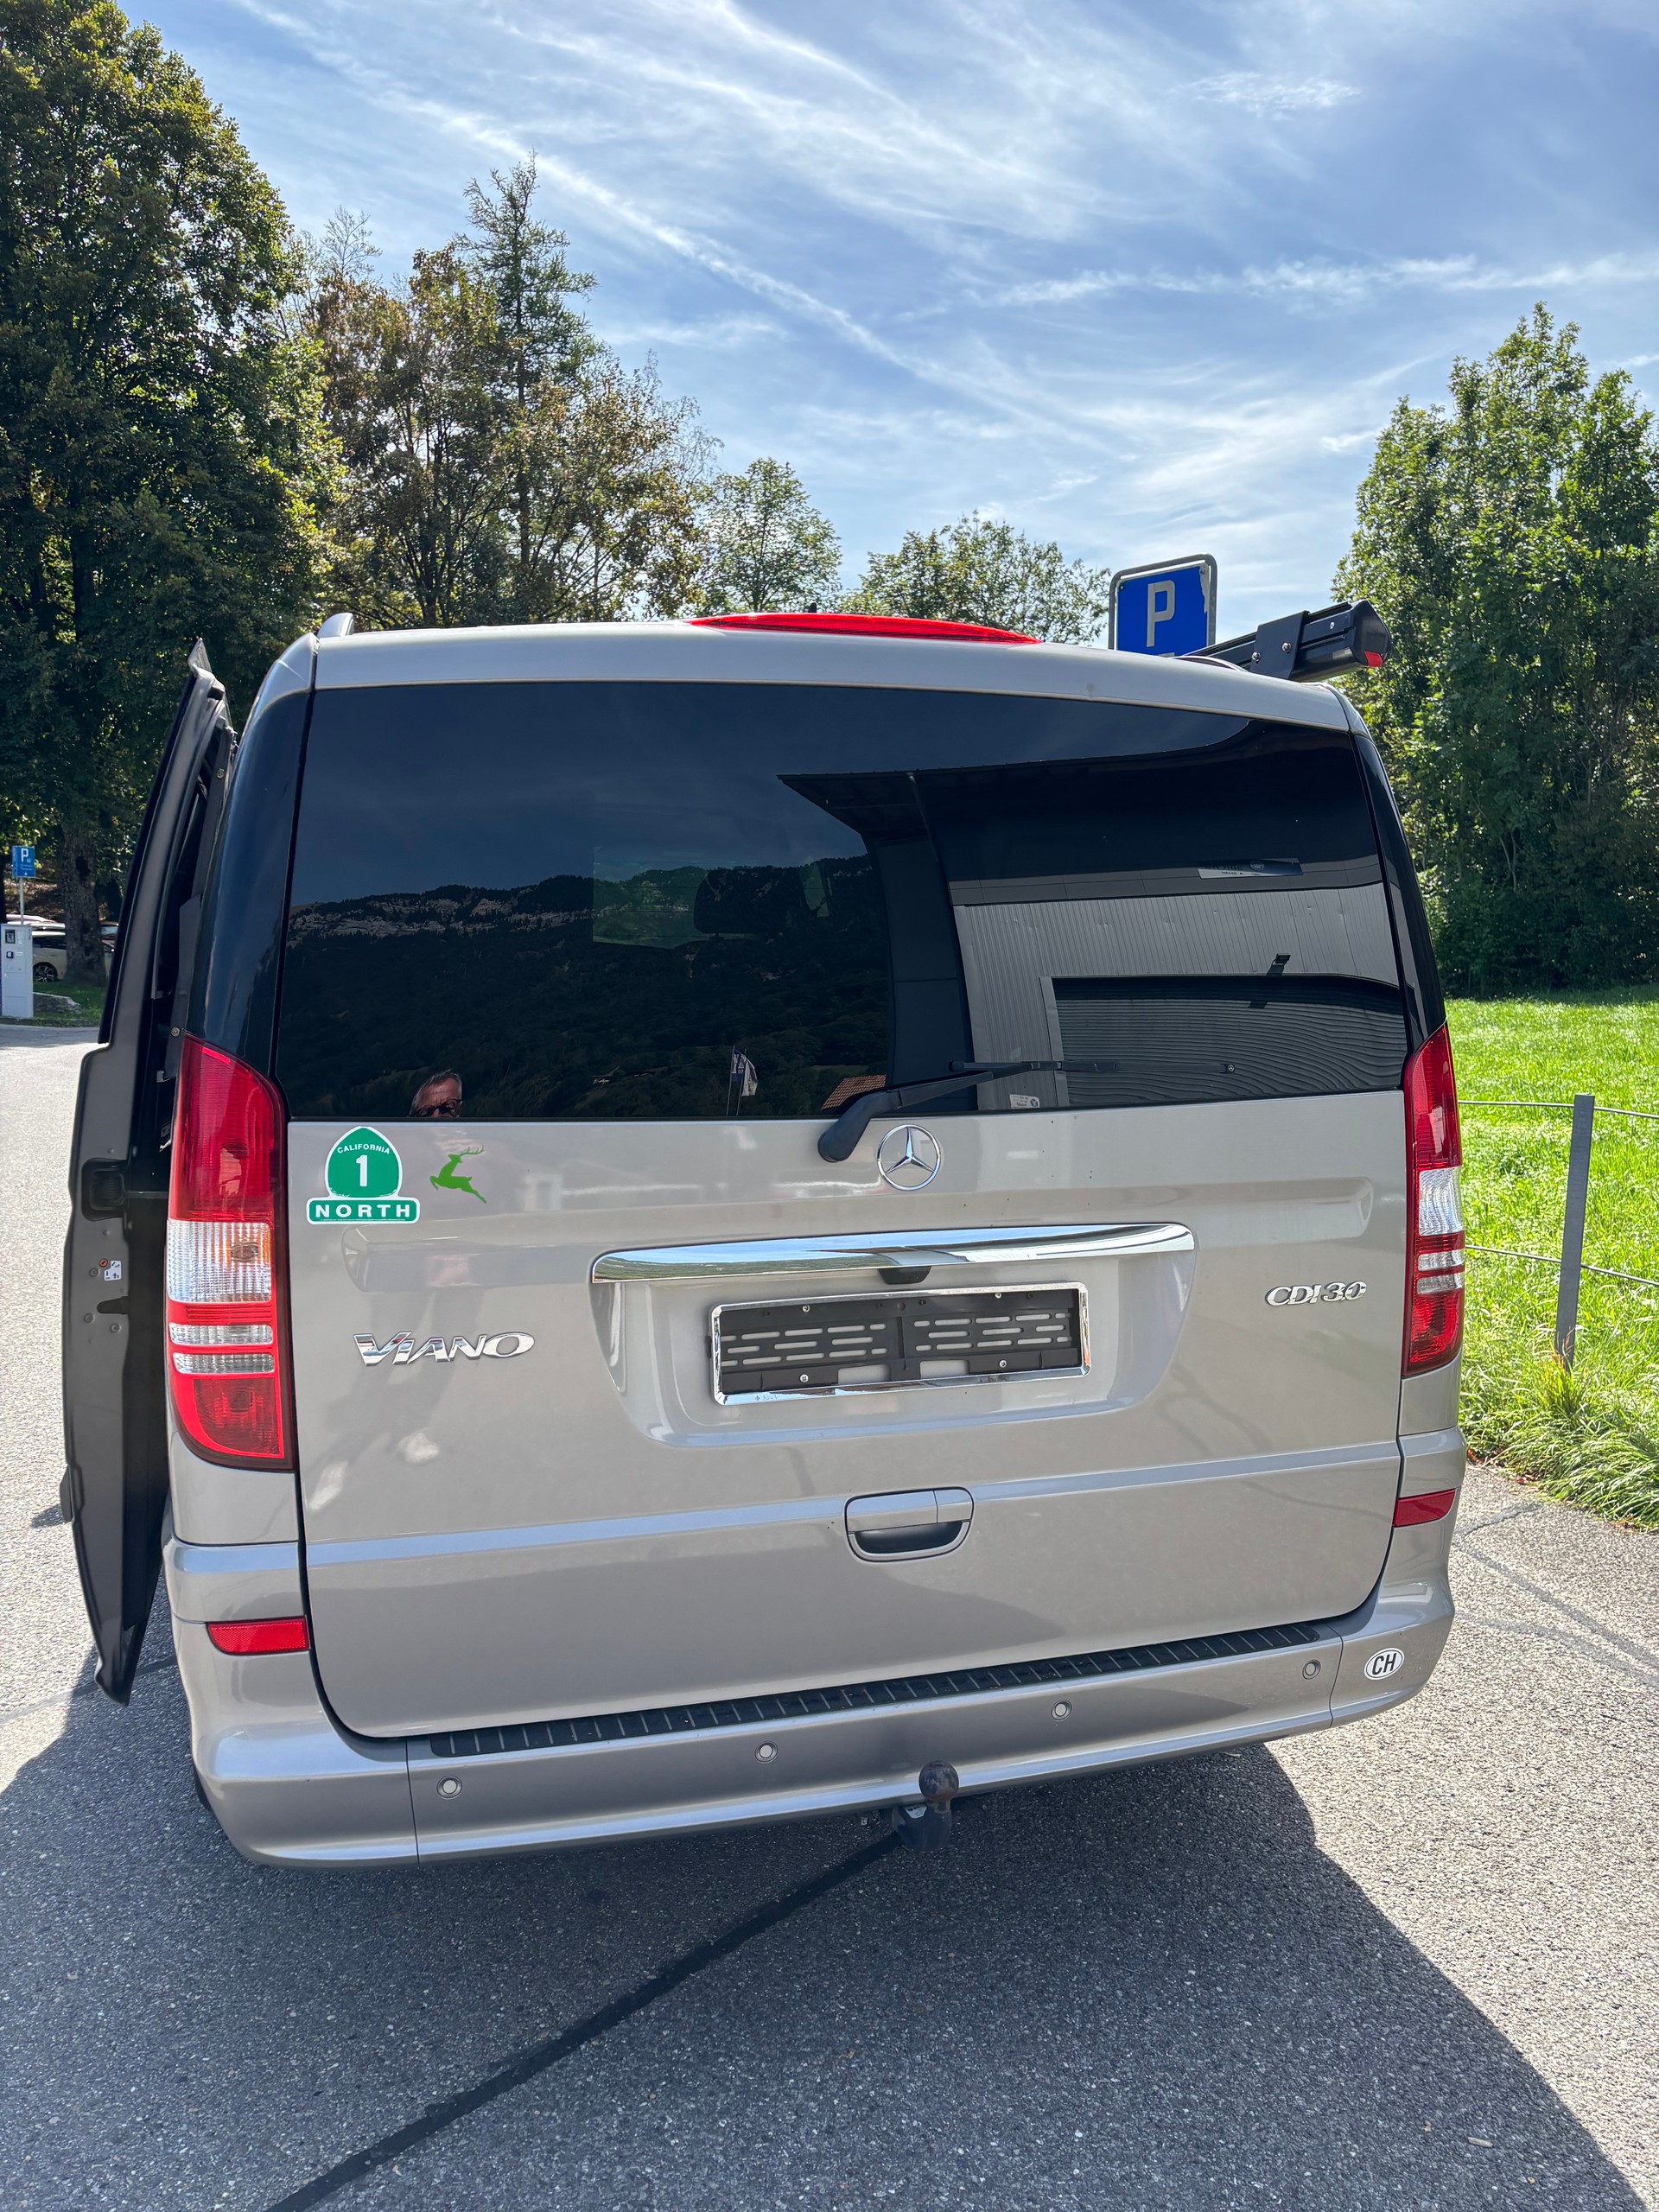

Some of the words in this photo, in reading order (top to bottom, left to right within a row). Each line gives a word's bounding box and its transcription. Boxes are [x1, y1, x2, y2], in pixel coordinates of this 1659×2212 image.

[1146, 580, 1175, 647] P
[21, 848, 29, 862] P
[337, 1143, 391, 1154] CALIFORNIA
[355, 1154, 368, 1187] 1
[315, 1204, 410, 1218] NORTH
[1264, 1284, 1322, 1306] CDI
[353, 1332, 535, 1366] VIANO
[1372, 1652, 1397, 1675] CH
